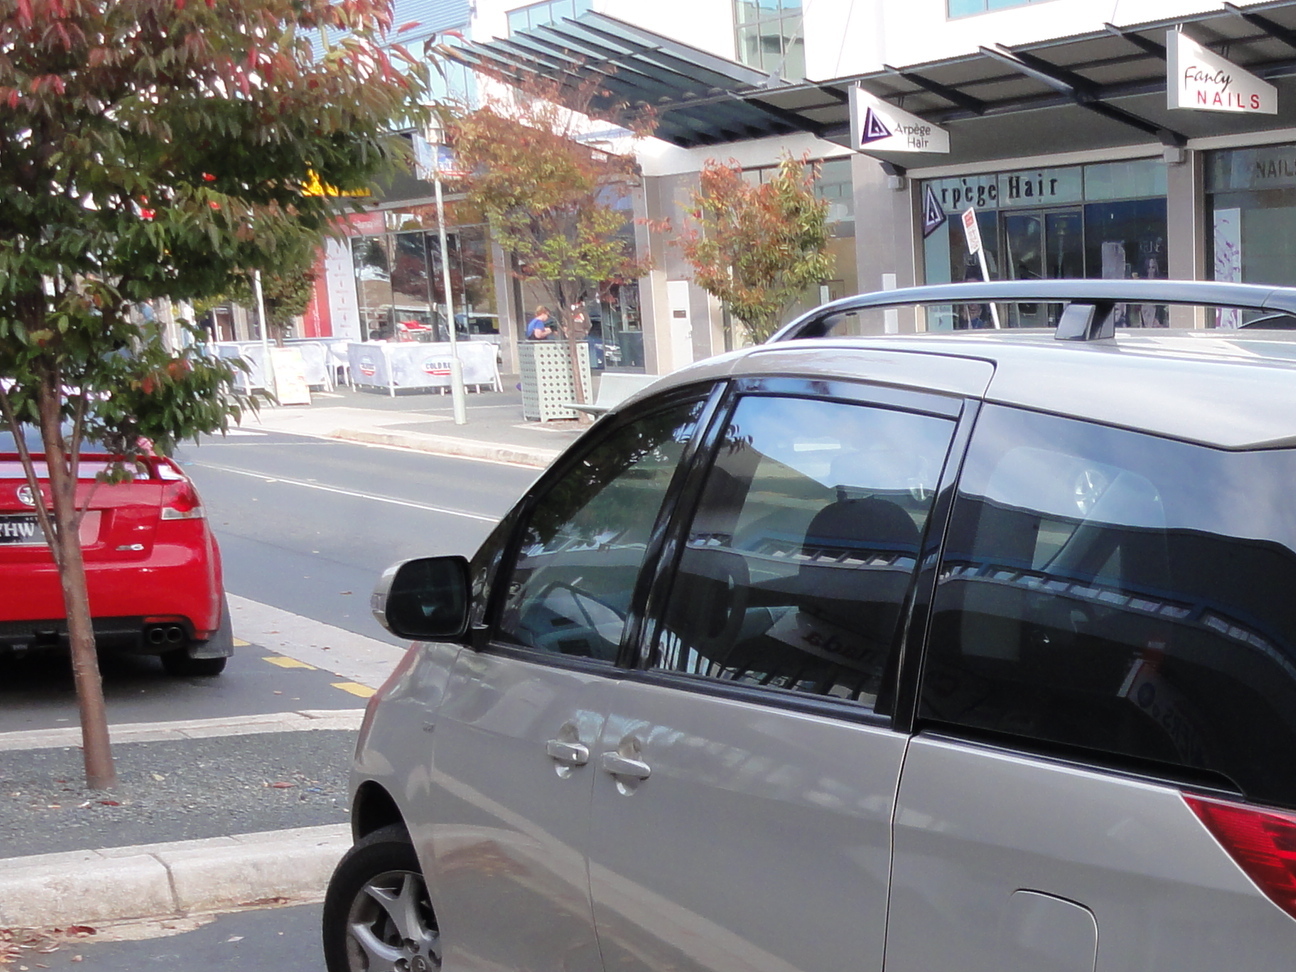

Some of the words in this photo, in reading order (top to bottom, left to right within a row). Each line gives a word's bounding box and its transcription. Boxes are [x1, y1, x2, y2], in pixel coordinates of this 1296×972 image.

[1184, 66, 1233, 93] Fancy
[1197, 90, 1260, 109] NAILS
[894, 123, 931, 137] Arpège
[907, 137, 929, 148] Hair
[1007, 173, 1058, 199] Hair
